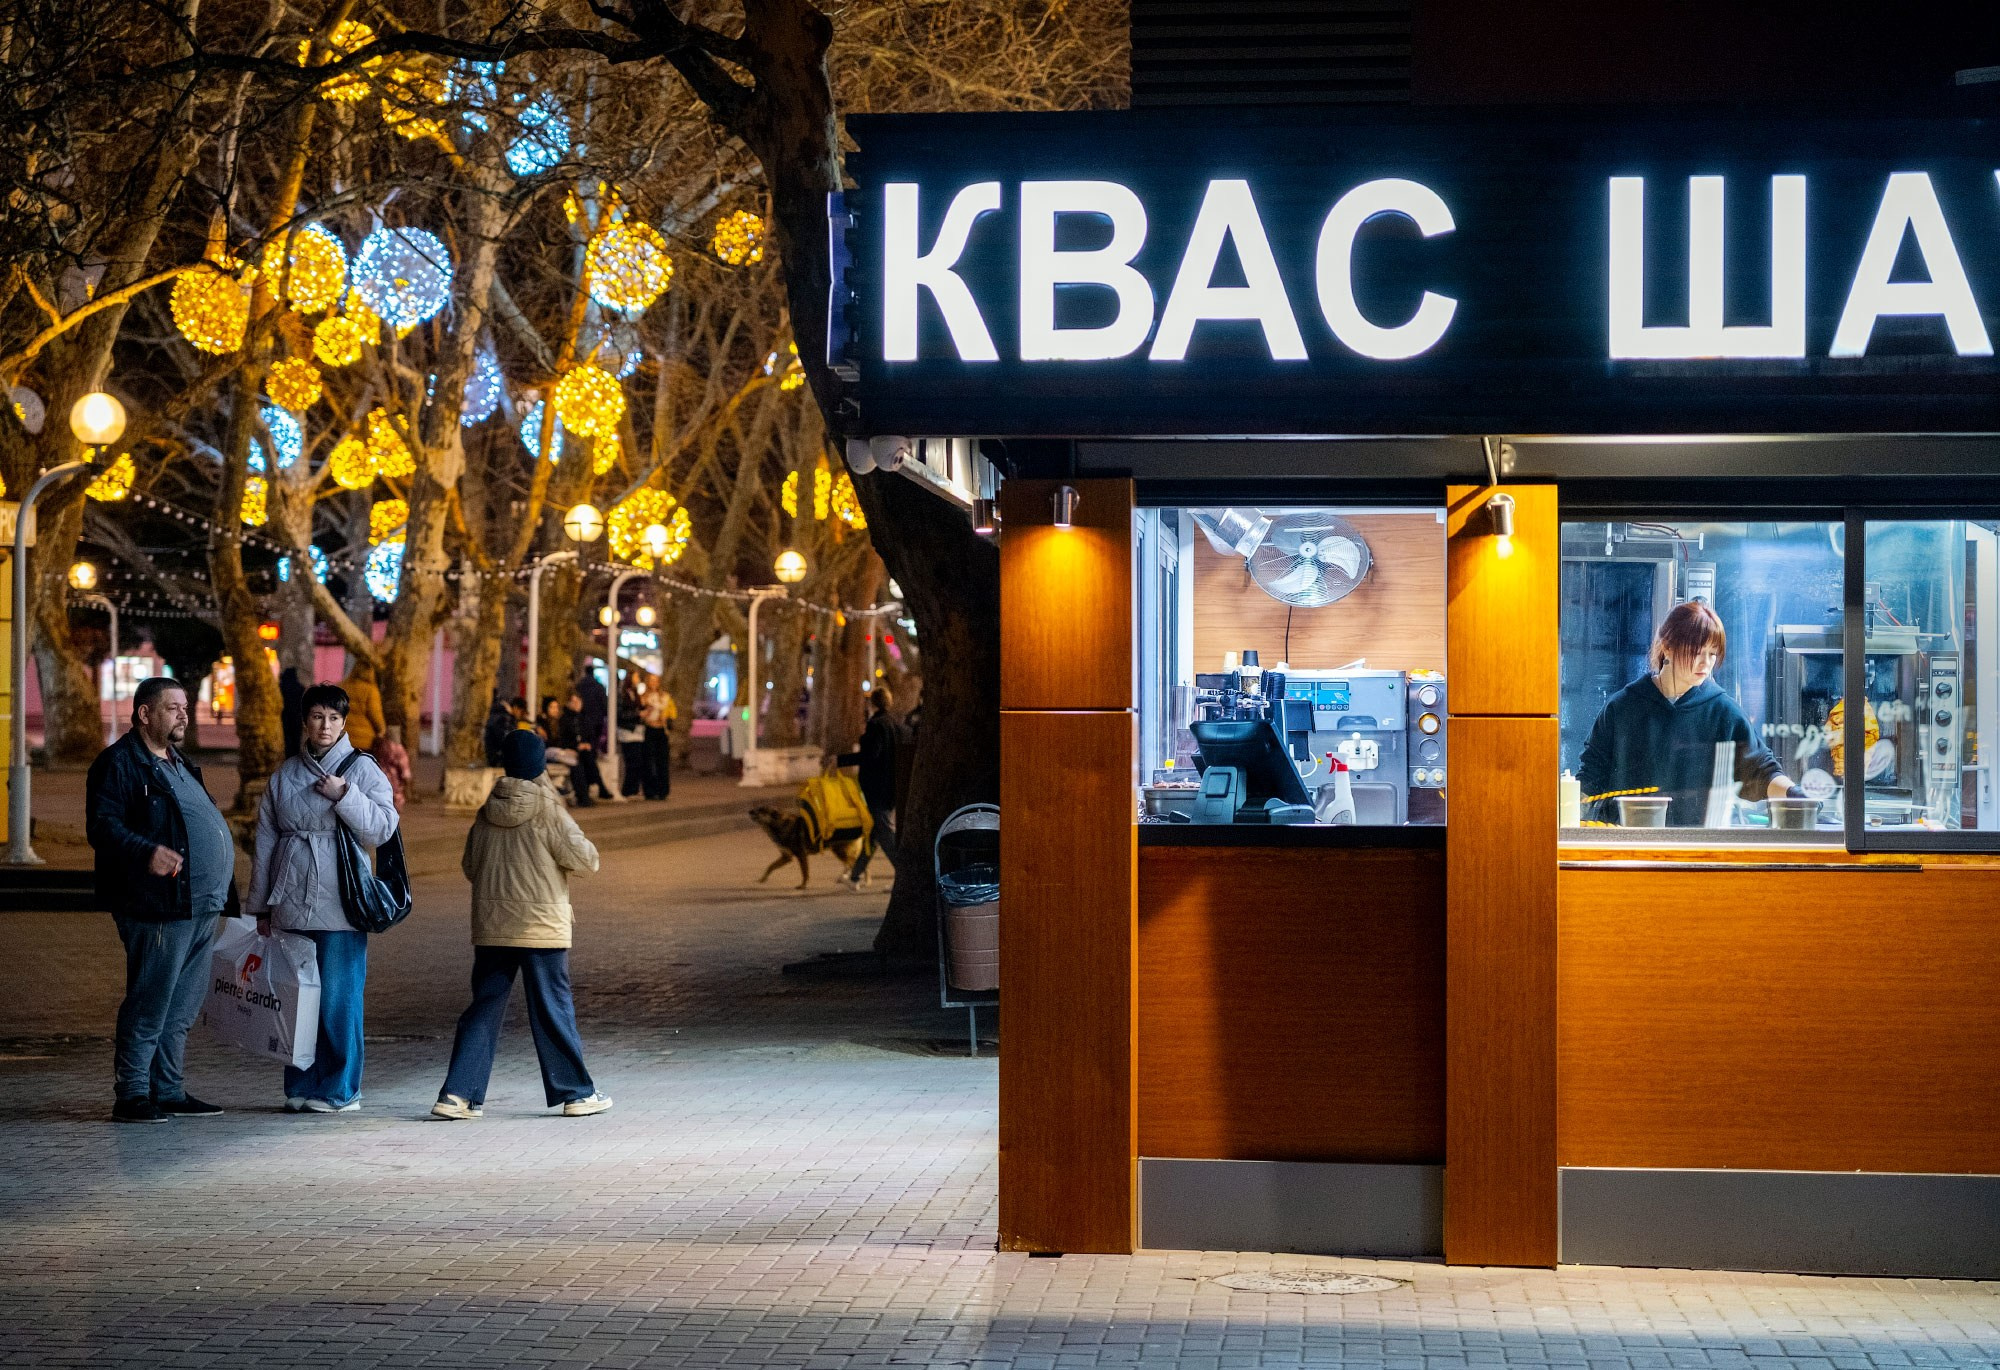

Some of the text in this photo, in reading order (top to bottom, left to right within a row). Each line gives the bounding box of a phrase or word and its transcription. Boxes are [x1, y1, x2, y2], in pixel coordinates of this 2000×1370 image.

[883, 169, 2000, 362] КВАС ША
[214, 977, 282, 1012] pierre cardin
